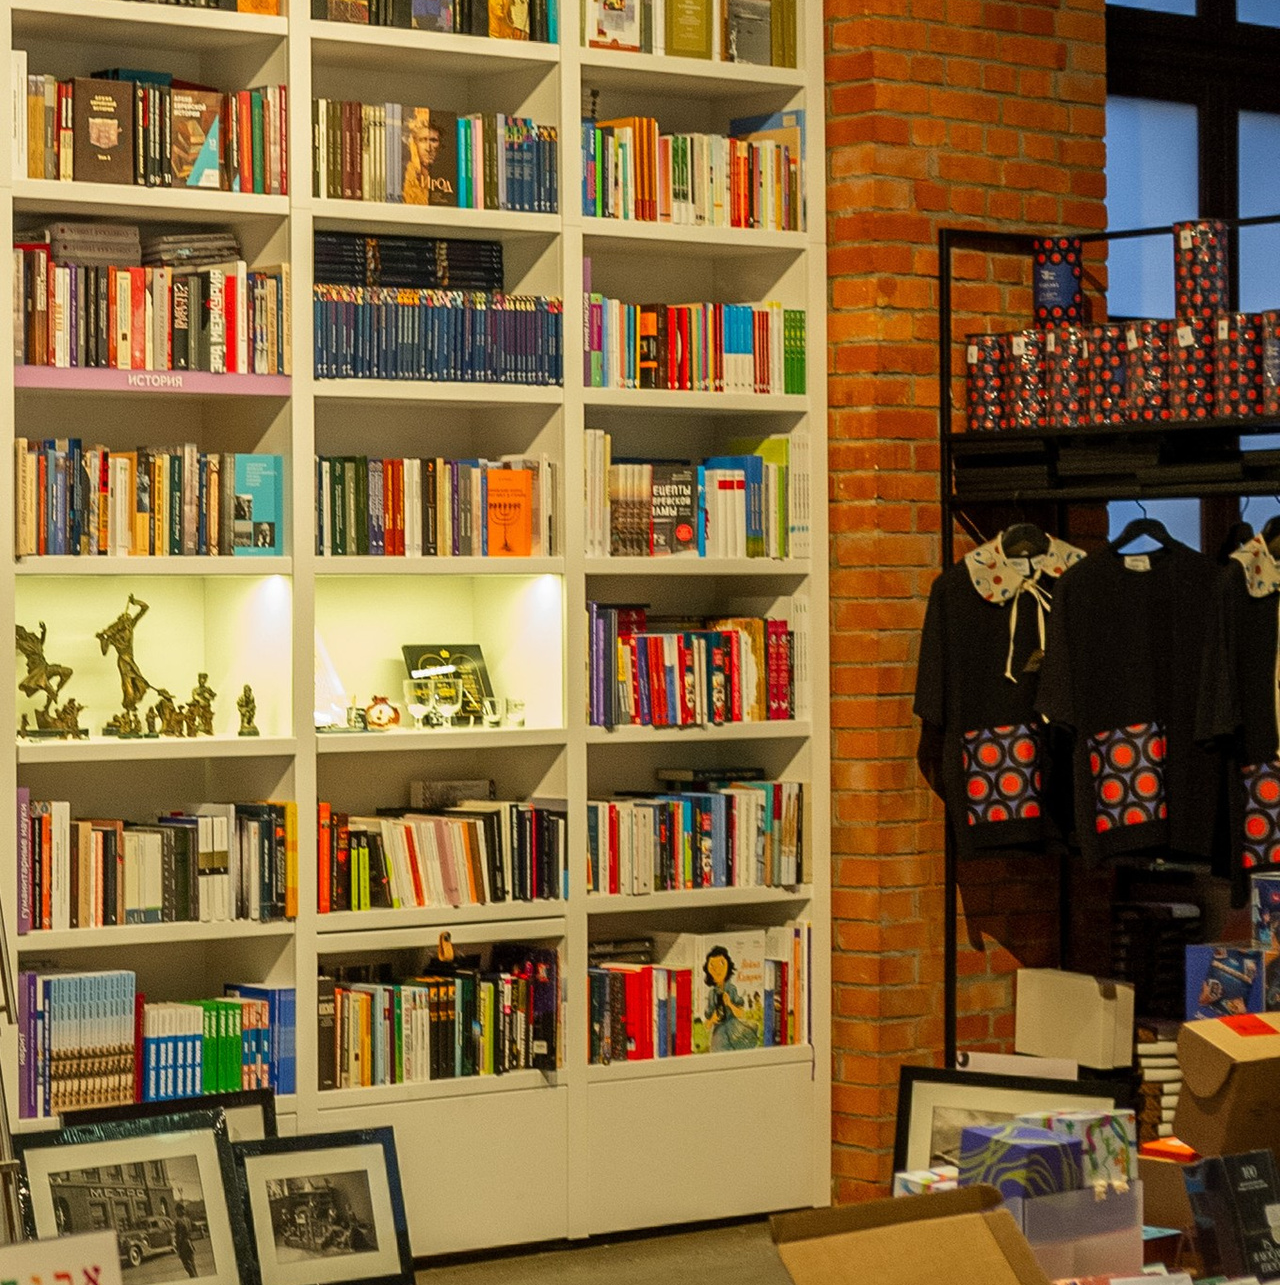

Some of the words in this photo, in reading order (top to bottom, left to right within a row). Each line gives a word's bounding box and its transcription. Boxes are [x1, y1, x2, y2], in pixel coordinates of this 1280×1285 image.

[209, 269, 223, 343] МЕРКУРИЯ
[209, 344, 223, 373] ЭРА
[128, 374, 183, 388] ИСТОРИЯ
[18, 1032, 27, 1065] иврит
